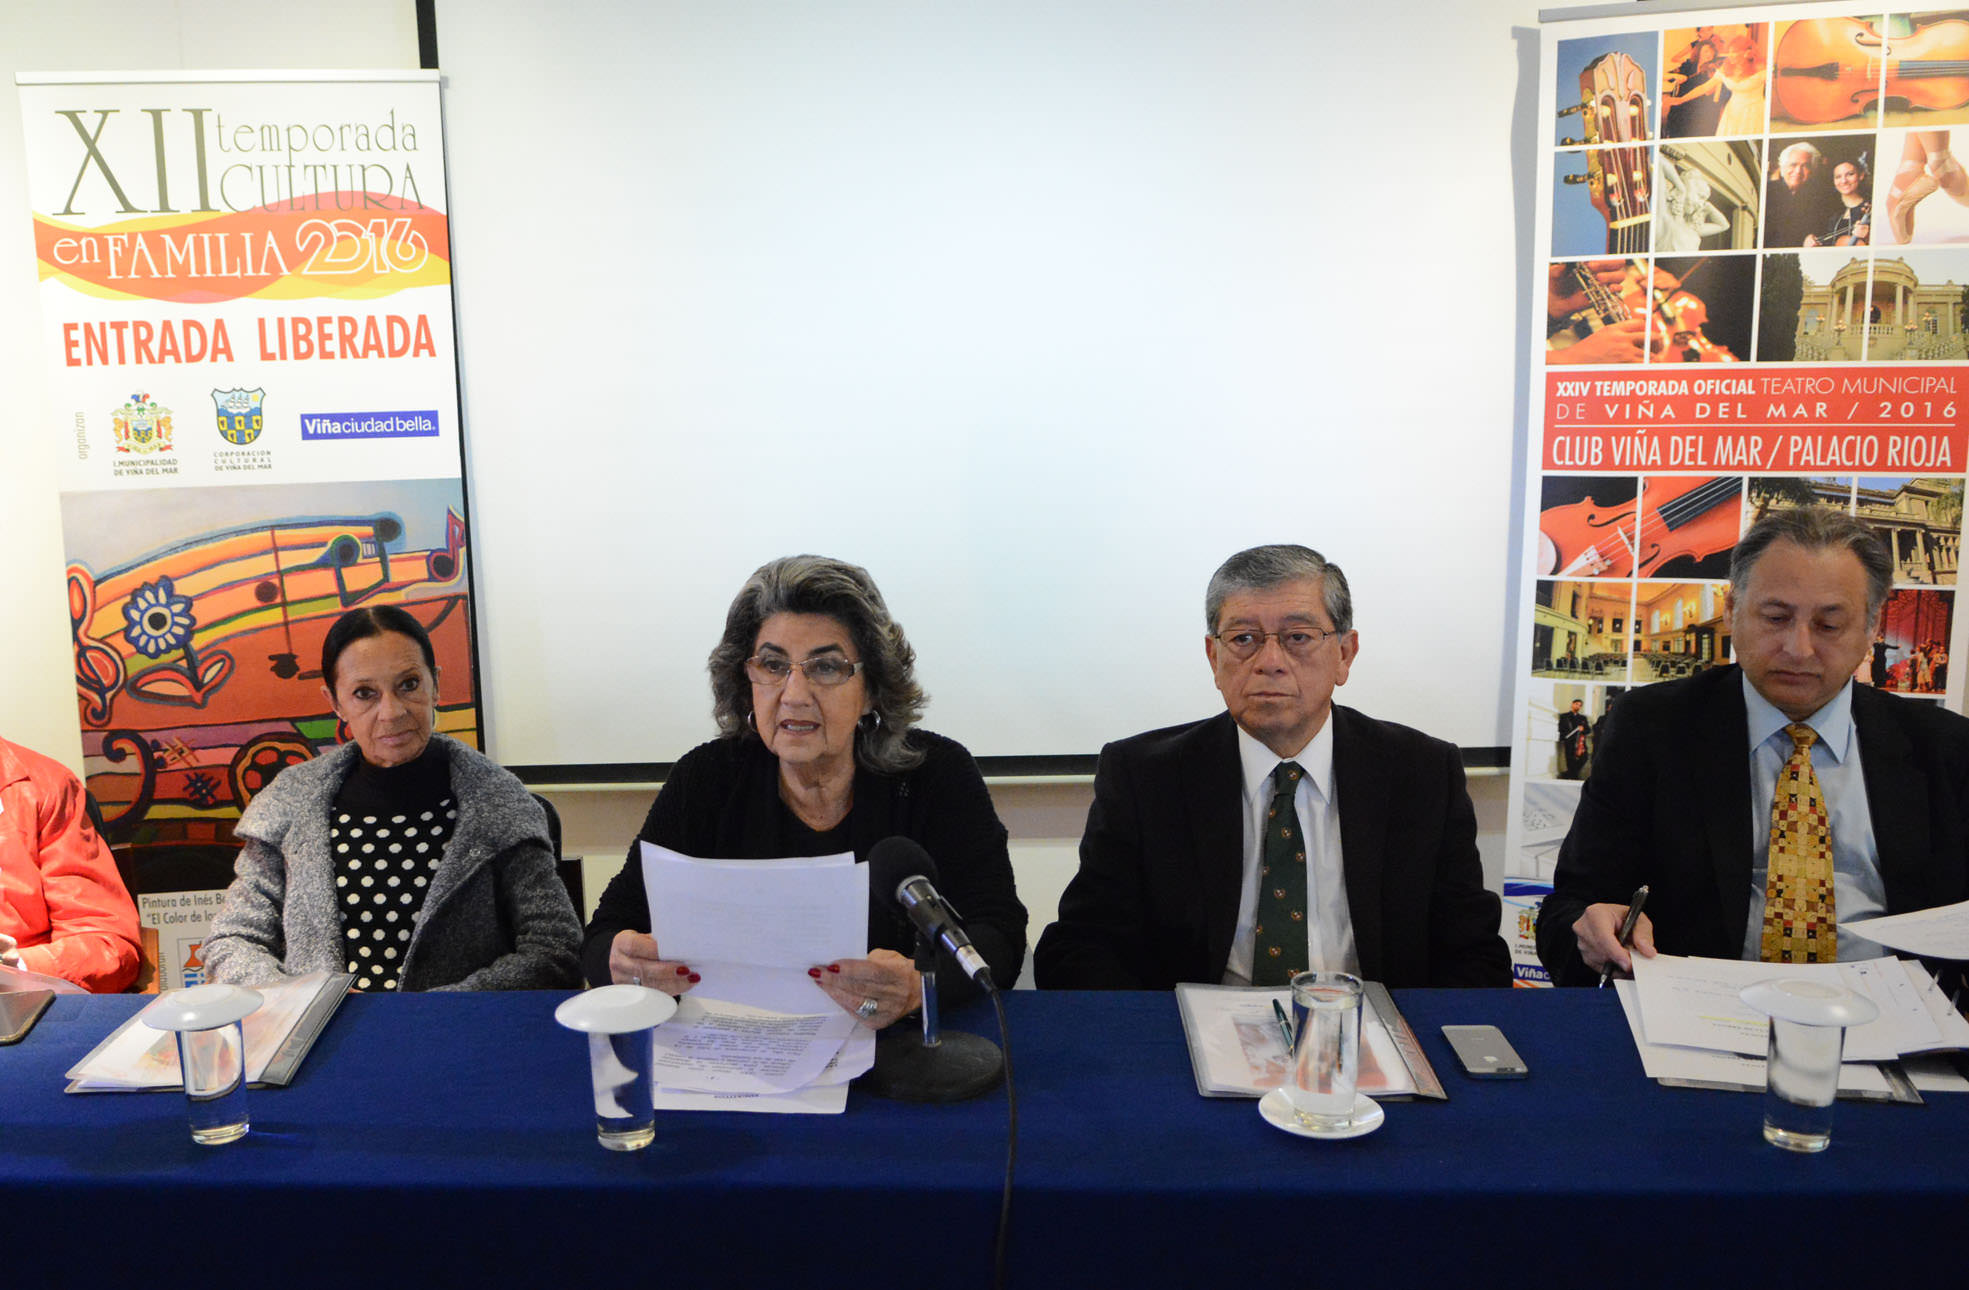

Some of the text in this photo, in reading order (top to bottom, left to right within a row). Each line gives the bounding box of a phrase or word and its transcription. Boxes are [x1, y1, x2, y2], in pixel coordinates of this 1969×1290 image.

[52, 108, 419, 215] XII temporada
[220, 162, 424, 212] CULTURA
[53, 218, 428, 278] en FAMILIA 2016
[63, 314, 437, 367] ENTRADA LIBERADA
[1556, 376, 1957, 397] XXIV TEMPORADA OFICIAL TEATRO MUNICIPAL
[1556, 403, 1585, 420] DE
[1604, 400, 1676, 419] VIÑA
[1695, 402, 1747, 419] DEL
[1766, 401, 1828, 419] MAR
[1879, 401, 1957, 419] 2016
[74, 411, 89, 460] organizan
[1552, 435, 1603, 467] CLUB
[1611, 428, 1662, 467] VIÑA
[1669, 435, 1708, 467] DEL
[1713, 435, 1763, 467] MAR
[1788, 435, 1879, 467] PALACIO
[1887, 435, 1952, 467] RIOJA
[114, 469, 124, 477] DE
[145, 467, 160, 475] DEL
[162, 466, 179, 474] MAR
[142, 896, 177, 909] Pintura
[179, 895, 191, 907] de
[194, 894, 213, 905] Inés
[163, 912, 187, 924] Color
[190, 910, 201, 922] de
